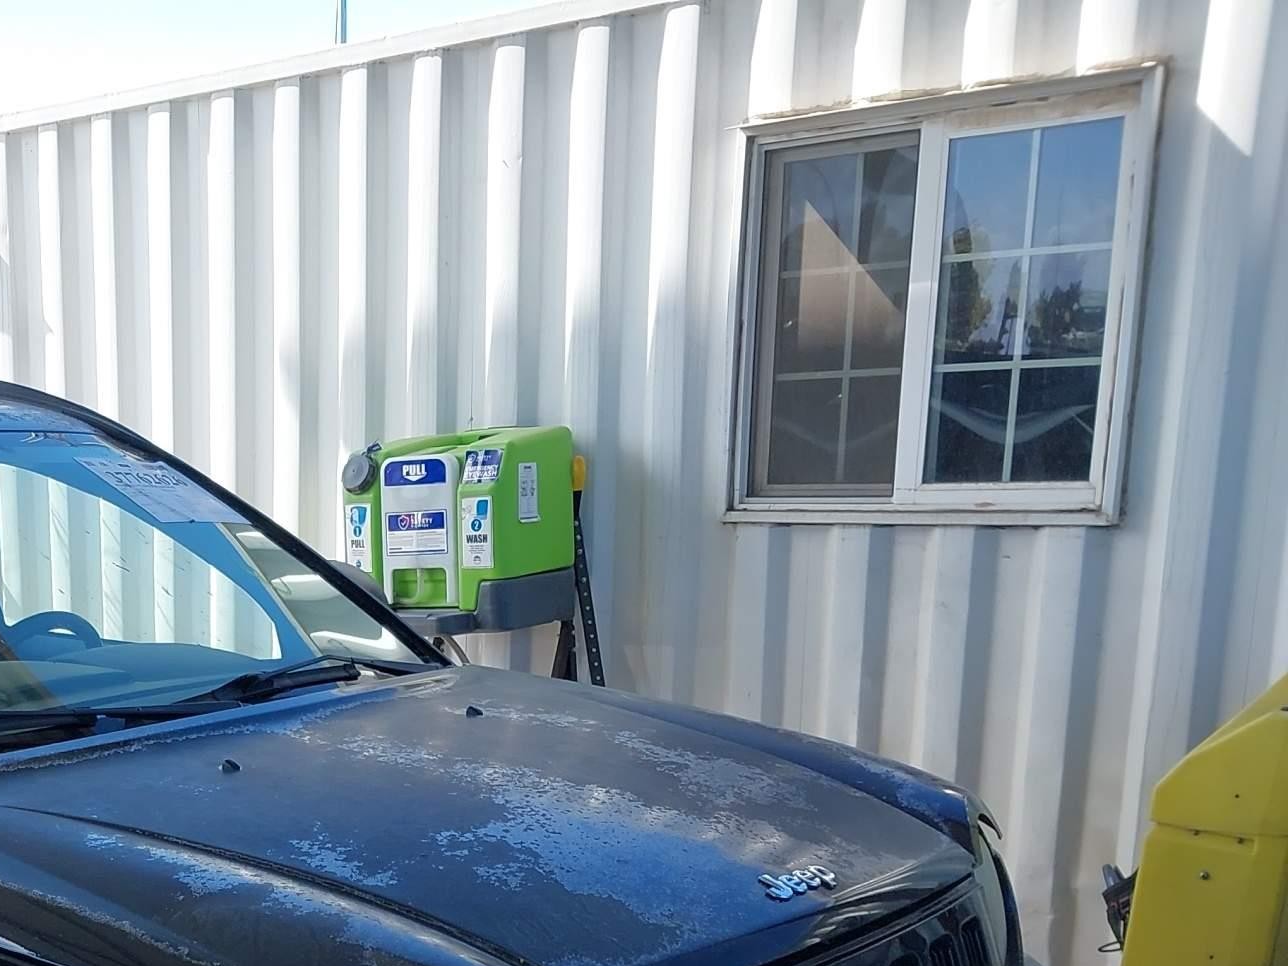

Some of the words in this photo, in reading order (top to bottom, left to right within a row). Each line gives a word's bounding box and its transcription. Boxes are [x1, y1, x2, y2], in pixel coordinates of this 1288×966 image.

[402, 463, 428, 477] PULL
[105, 471, 188, 487] 37762626
[473, 520, 480, 530] 2
[351, 539, 365, 549] PULL
[466, 534, 488, 544] WASH
[758, 865, 838, 902] Jeep
